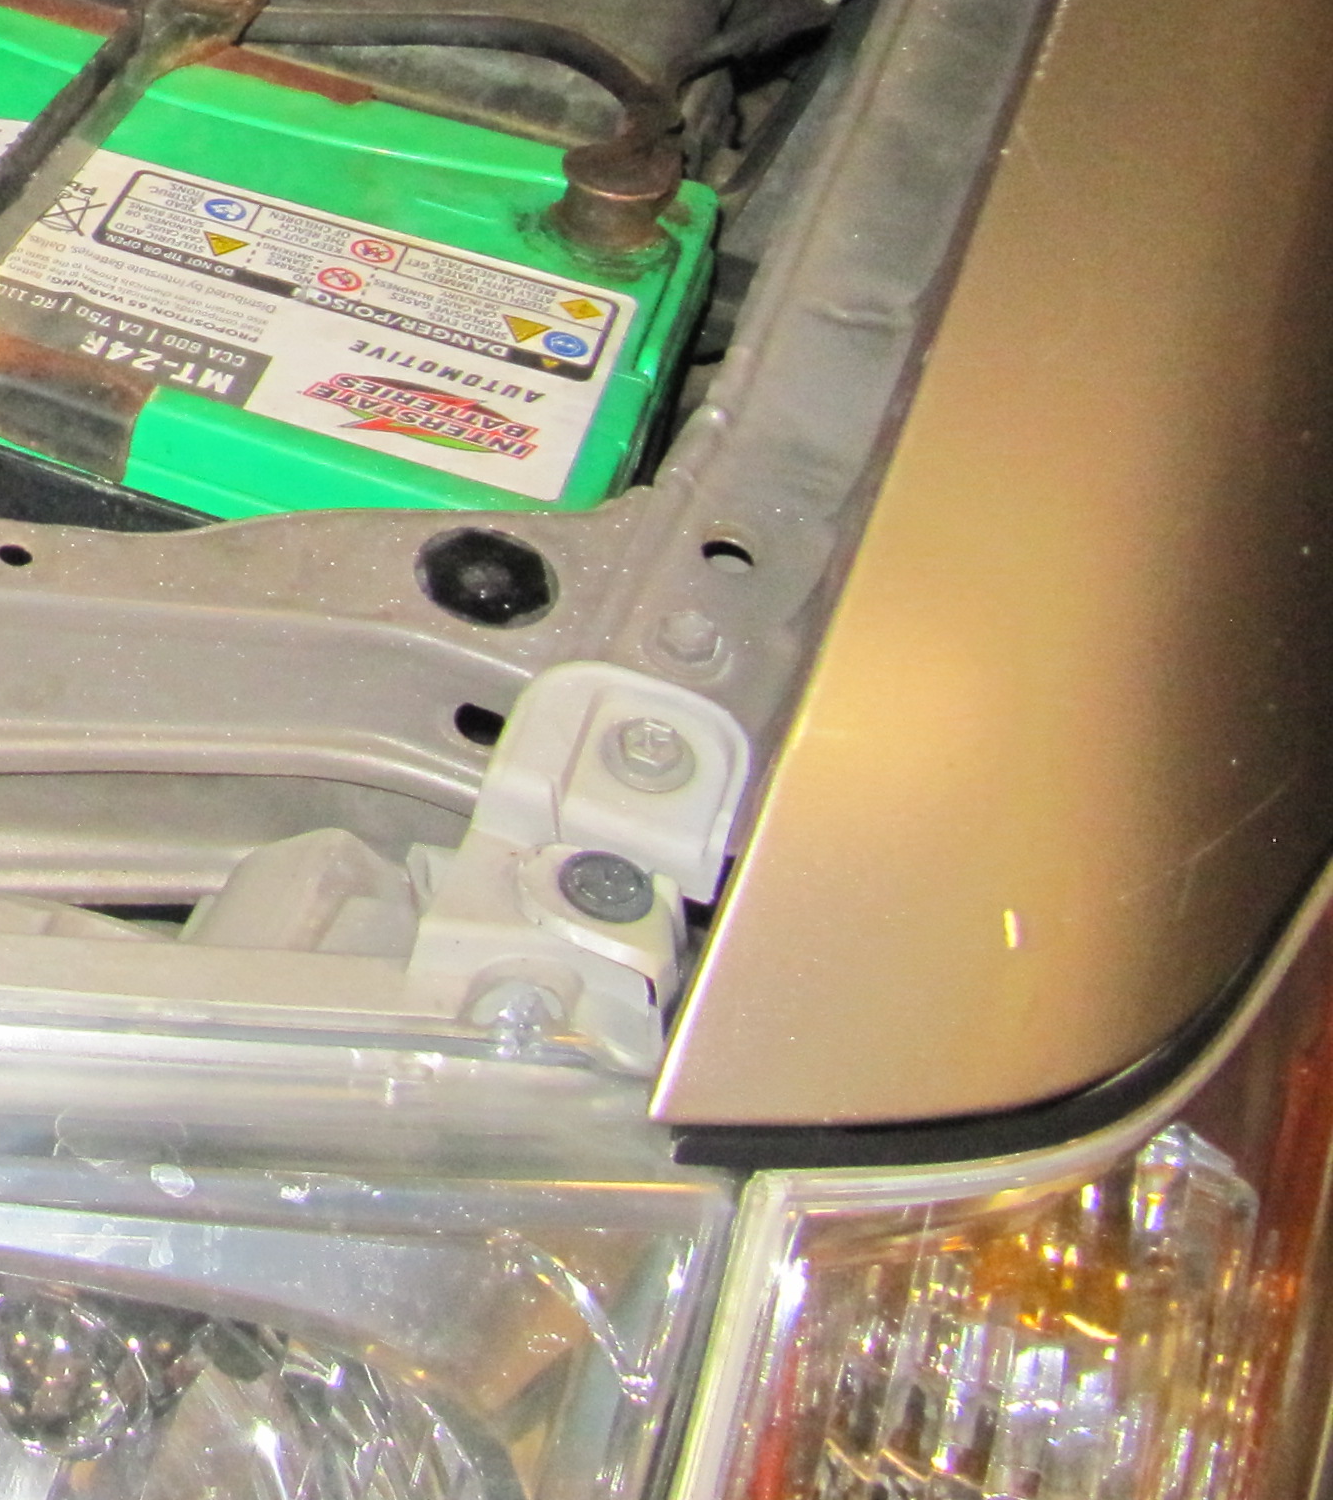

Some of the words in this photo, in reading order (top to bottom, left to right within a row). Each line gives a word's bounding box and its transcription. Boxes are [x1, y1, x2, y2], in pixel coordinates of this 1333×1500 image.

[123, 208, 141, 218] OR
[166, 212, 205, 227] SEVERE
[112, 221, 145, 236] ACID
[141, 213, 201, 234] BLINDNESS
[144, 222, 180, 237] CAUSE
[262, 226, 281, 236] OF
[278, 221, 321, 239] REACH
[100, 231, 142, 249] OPEN.
[146, 230, 206, 253] SULFURIC
[180, 232, 203, 244] CAN
[280, 230, 310, 244] OUT
[321, 234, 347, 246] THE
[331, 228, 351, 239] OF
[140, 243, 162, 255] OR
[260, 241, 315, 262] SMOKING
[309, 239, 343, 254] KEEP
[161, 249, 184, 261] TIP
[185, 255, 213, 269] NOT
[267, 251, 311, 268] FLAMES
[213, 263, 235, 275] DO
[264, 257, 308, 275] SPARKS
[403, 257, 430, 270] GET
[123, 262, 186, 287] Interstate
[290, 272, 313, 284] NO
[462, 264, 495, 280] HELP
[185, 278, 205, 292] by
[371, 277, 434, 300] BLINDNESS
[475, 286, 506, 300] EYES
[479, 277, 515, 293] WITH
[499, 274, 558, 297] MEDICAL
[29, 293, 57, 309] RC
[126, 298, 148, 310] 65
[203, 286, 276, 313] Distributed
[388, 291, 432, 309] GASES
[436, 296, 471, 311] CAUSE
[507, 294, 551, 312] FLUSH
[515, 287, 555, 305] ATELY
[470, 306, 497, 318] CAN
[482, 301, 500, 311] OR
[72, 304, 116, 327] 750
[433, 303, 502, 329] EXPLOSIVE
[114, 319, 144, 336] CA
[149, 305, 259, 343] PROPOSITION
[461, 320, 509, 340] SHIELD
[160, 332, 203, 354] 600
[203, 345, 247, 367] CCA
[346, 337, 545, 406] AUTOMOTIVE
[332, 372, 528, 440] BATTERIES
[308, 381, 530, 459] INTERSTATE
